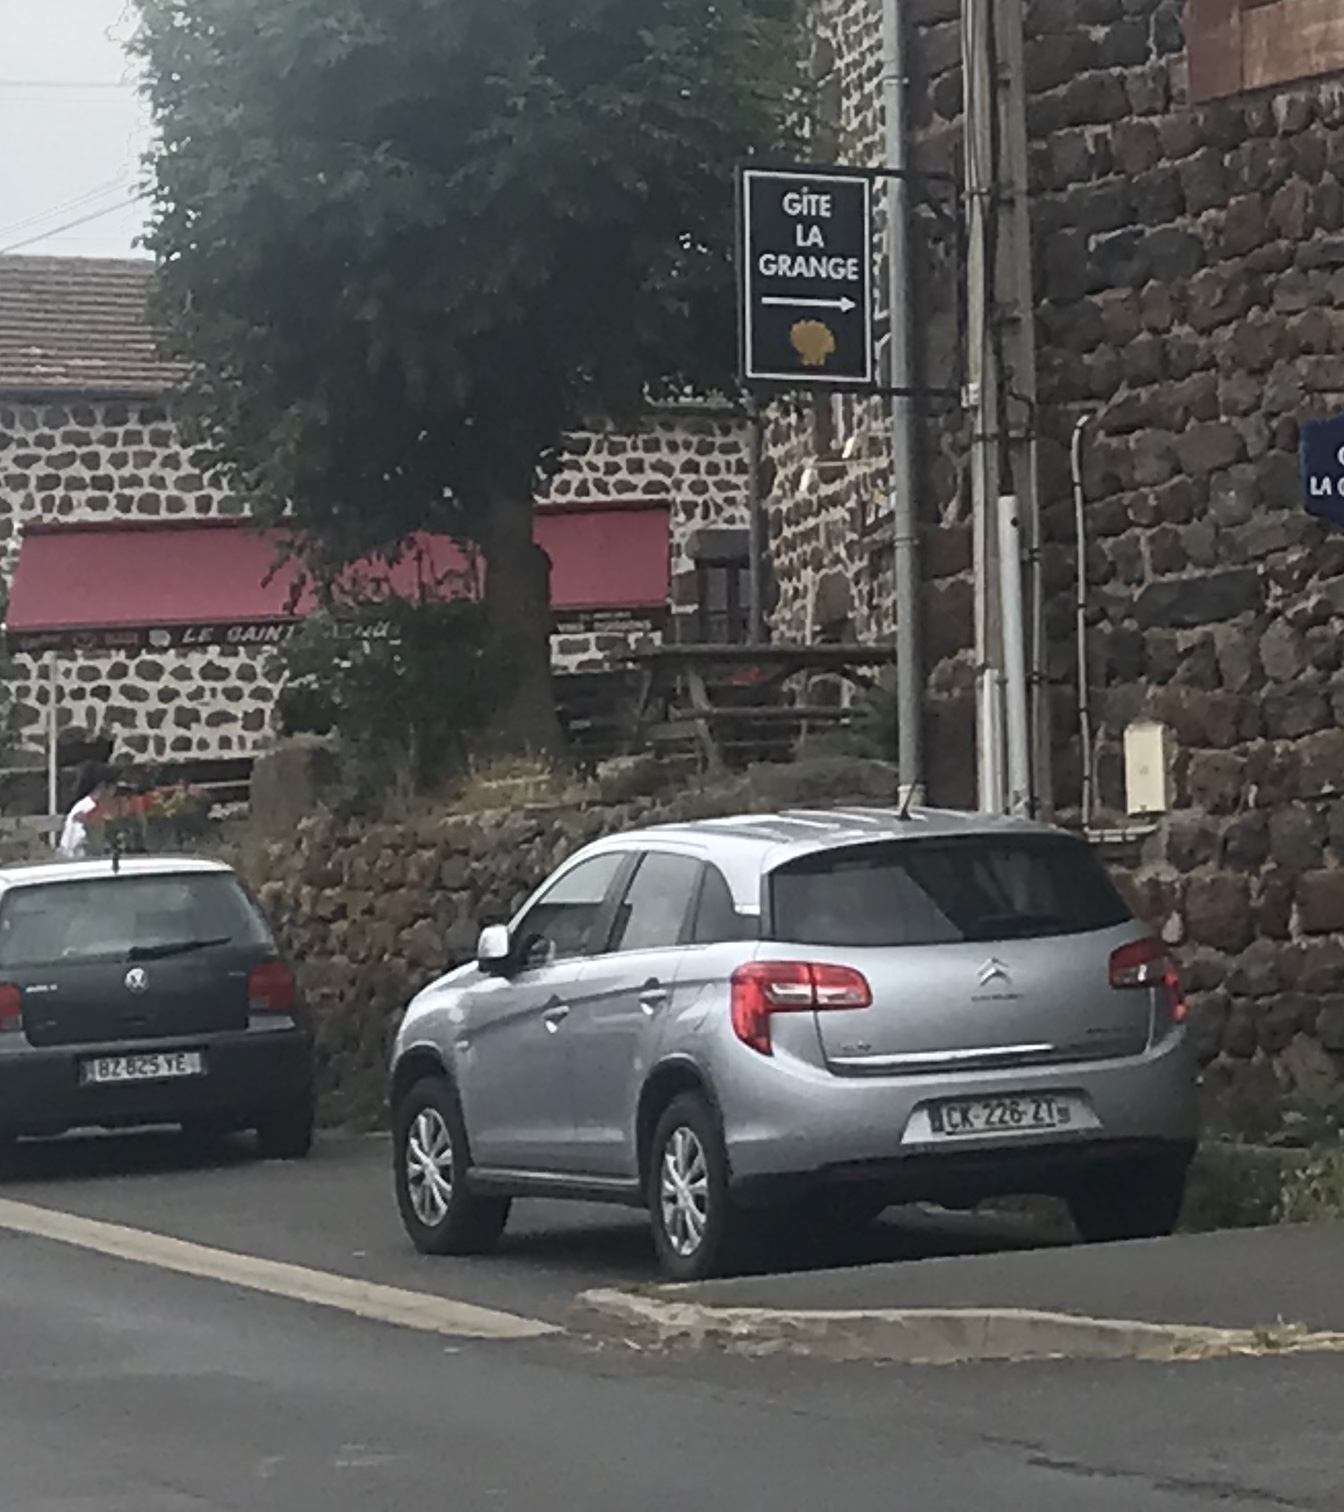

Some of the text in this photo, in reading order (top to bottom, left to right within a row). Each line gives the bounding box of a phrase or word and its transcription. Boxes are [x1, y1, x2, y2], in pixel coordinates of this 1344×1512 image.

[795, 223, 825, 248] LA
[758, 253, 859, 281] GRANGE
[1310, 476, 1332, 496] LA
